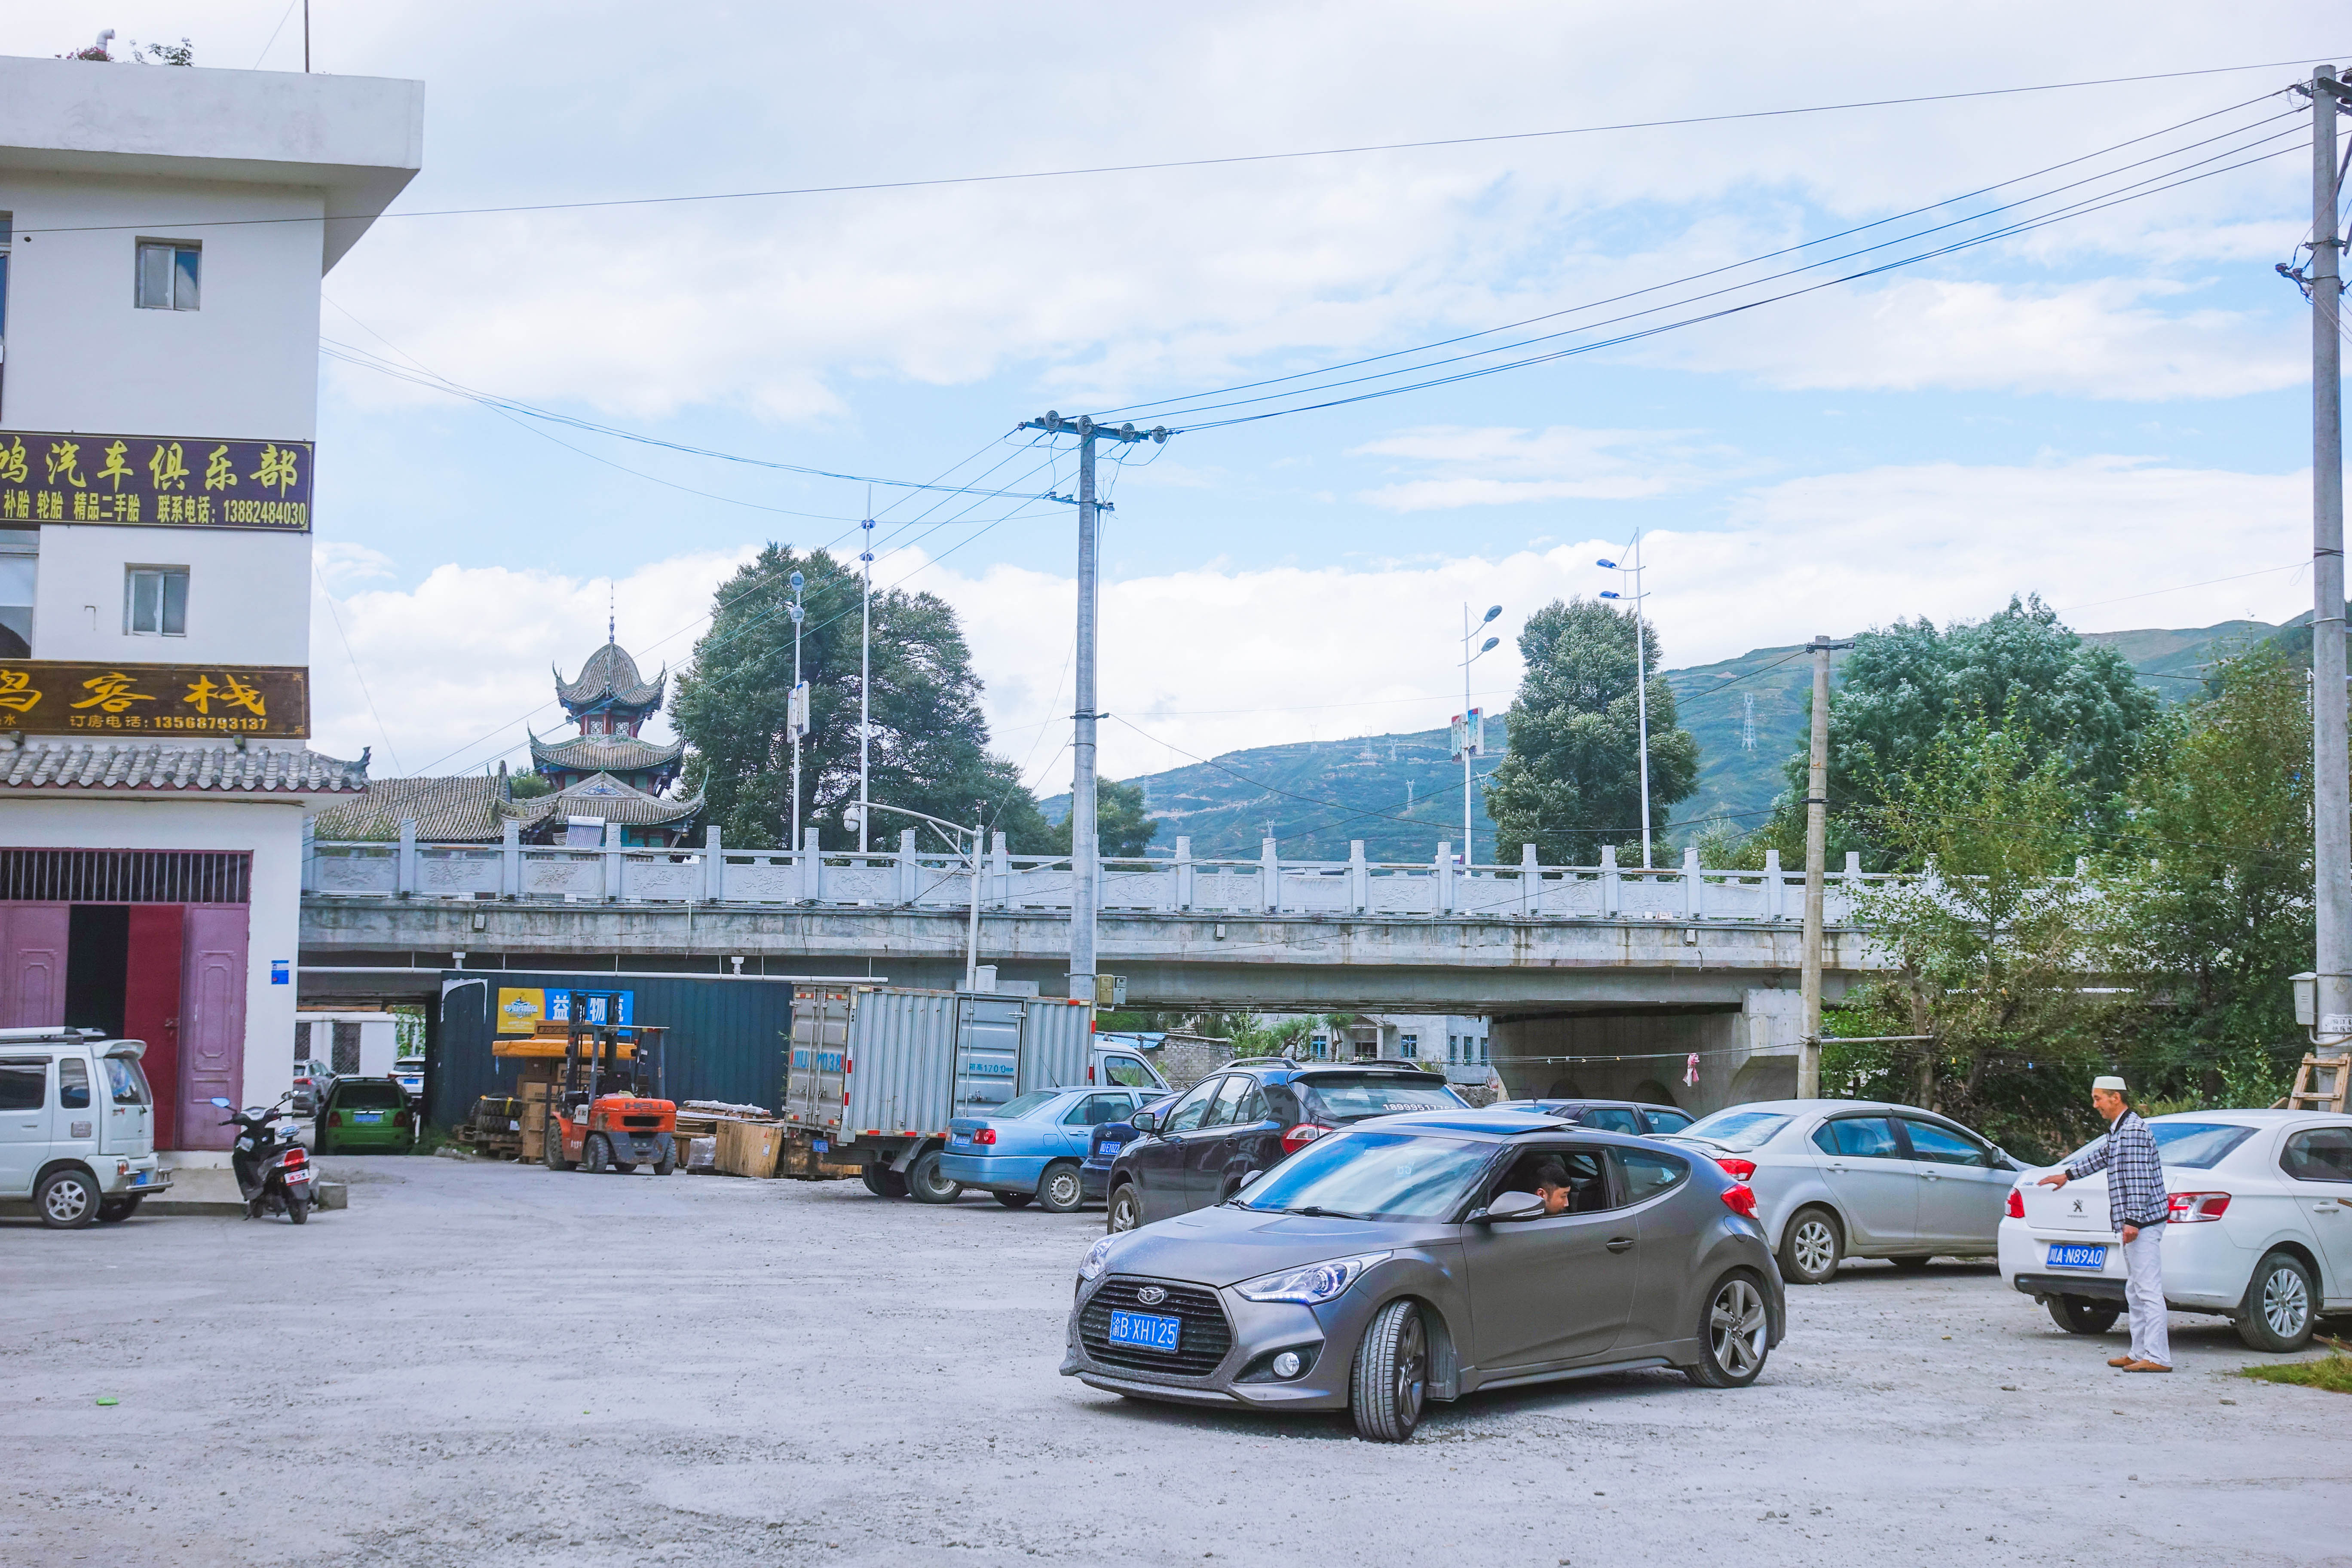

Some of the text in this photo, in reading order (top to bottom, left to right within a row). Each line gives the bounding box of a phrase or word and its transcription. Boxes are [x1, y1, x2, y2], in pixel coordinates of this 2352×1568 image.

[4, 489, 30, 518] 补胎
[37, 490, 64, 519] 轮胎
[74, 491, 141, 522] 精品二手胎
[224, 499, 306, 525] 13882484030
